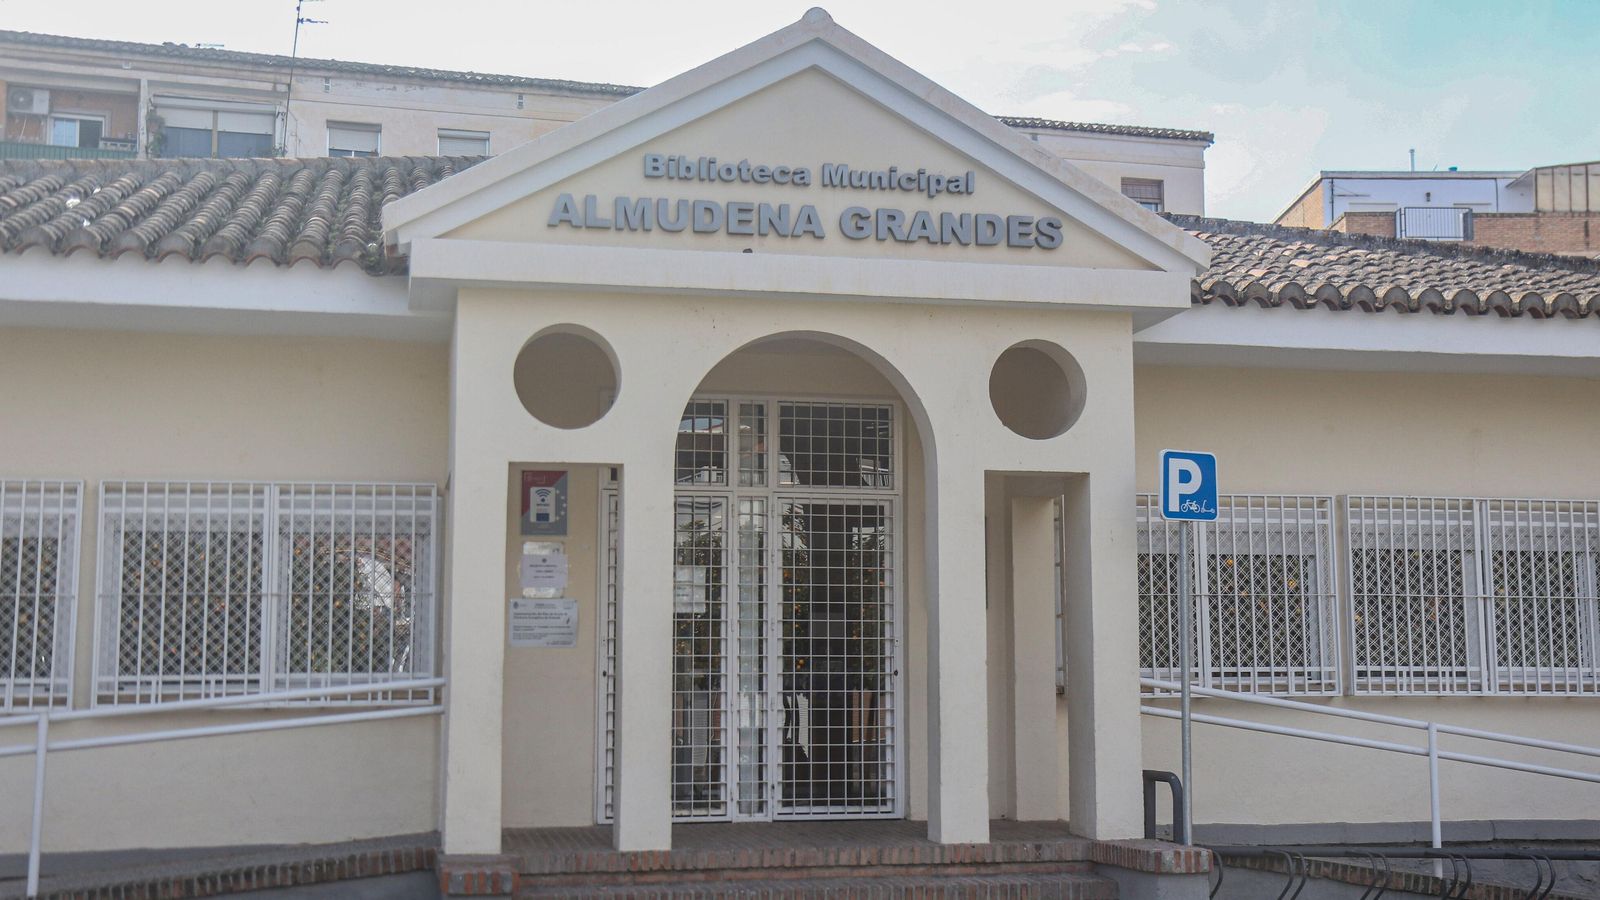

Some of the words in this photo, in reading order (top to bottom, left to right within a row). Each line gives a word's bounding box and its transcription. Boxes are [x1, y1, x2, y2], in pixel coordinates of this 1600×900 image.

[644, 154, 811, 187] Biblioteca
[822, 163, 975, 198] Municipal
[547, 193, 825, 237] ALMUDENA
[839, 206, 1064, 250] GRANDES
[1168, 457, 1202, 512] P
